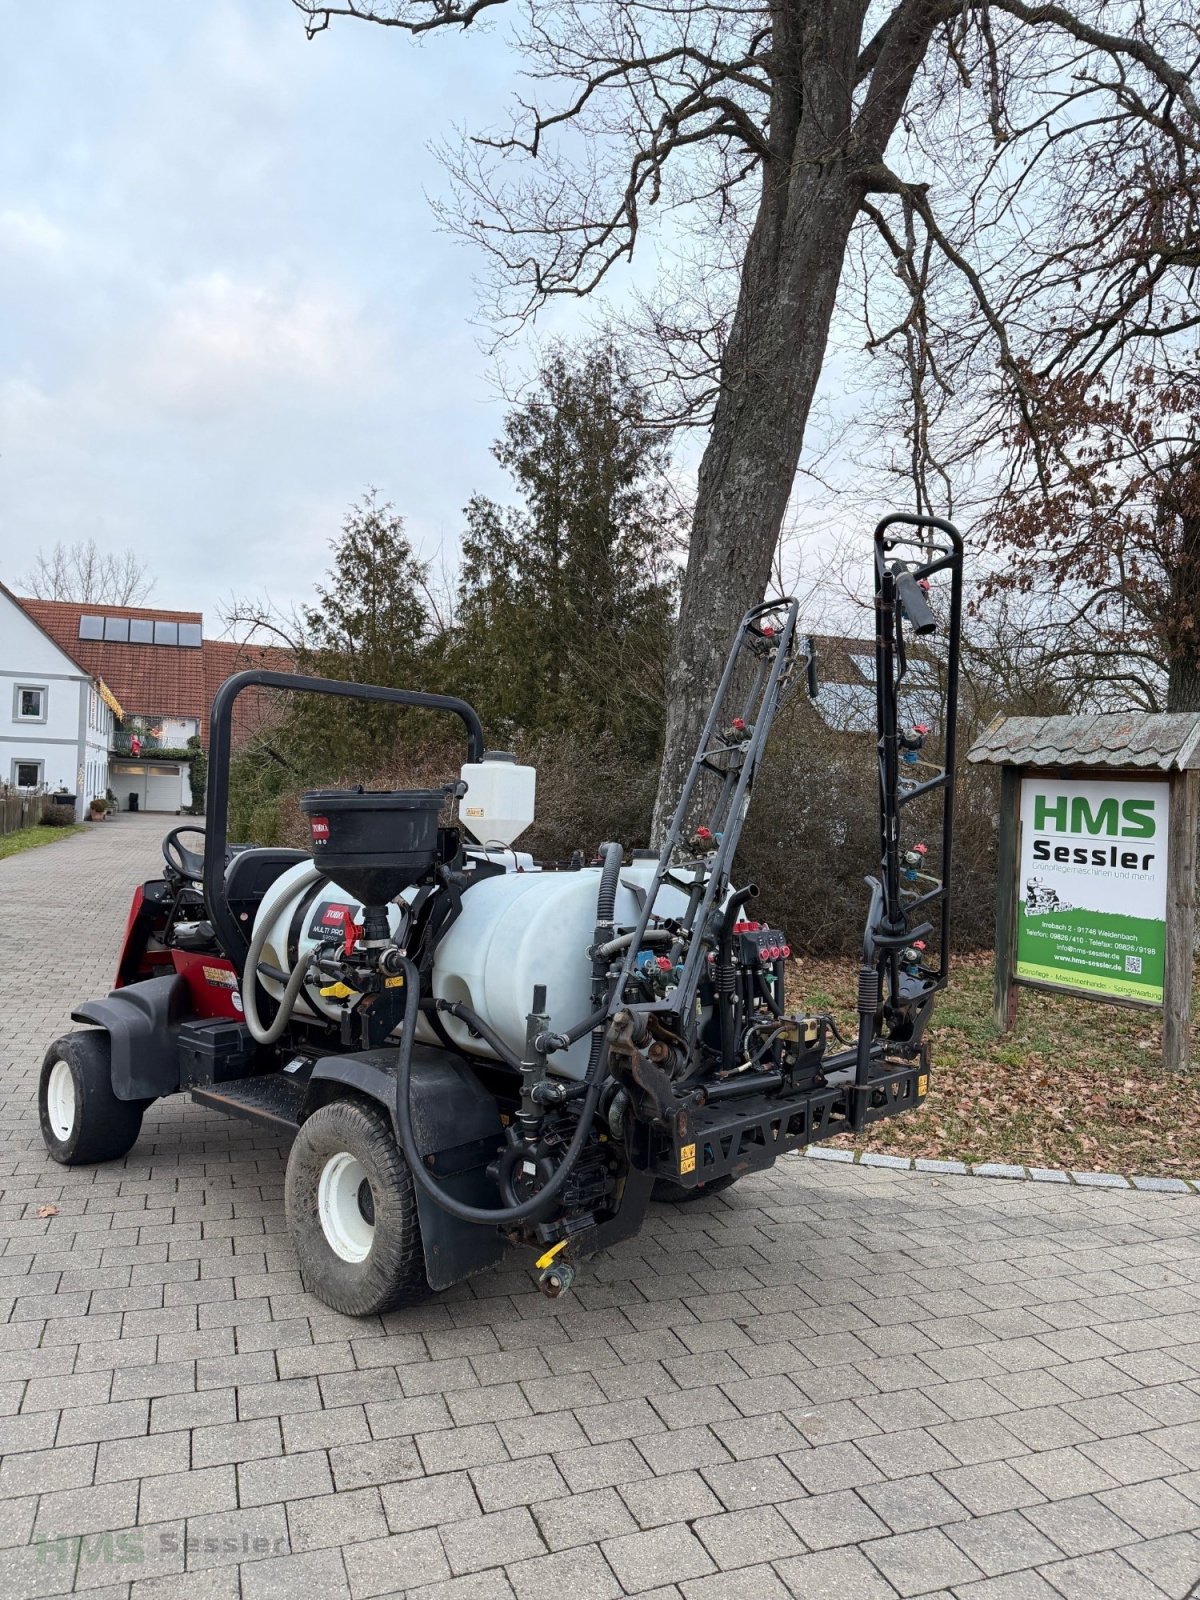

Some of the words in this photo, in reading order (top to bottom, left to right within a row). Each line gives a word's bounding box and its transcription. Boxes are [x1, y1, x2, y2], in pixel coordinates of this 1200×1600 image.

[1034, 795, 1156, 839] HMS
[1032, 840, 1155, 871] Sessler
[1031, 861, 1113, 878] Grünpflegemaschinen
[1114, 870, 1130, 880] und
[326, 910, 344, 919] TORO
[313, 926, 330, 934] MULTI
[330, 928, 344, 936] PRO
[1026, 928, 1049, 939] Telefon:
[1088, 938, 1113, 948] Telefax:
[1097, 928, 1138, 942] Weidenbach
[1056, 943, 1120, 960] info@hms-sessler.de
[1053, 954, 1122, 971] www.hms-sessler.de
